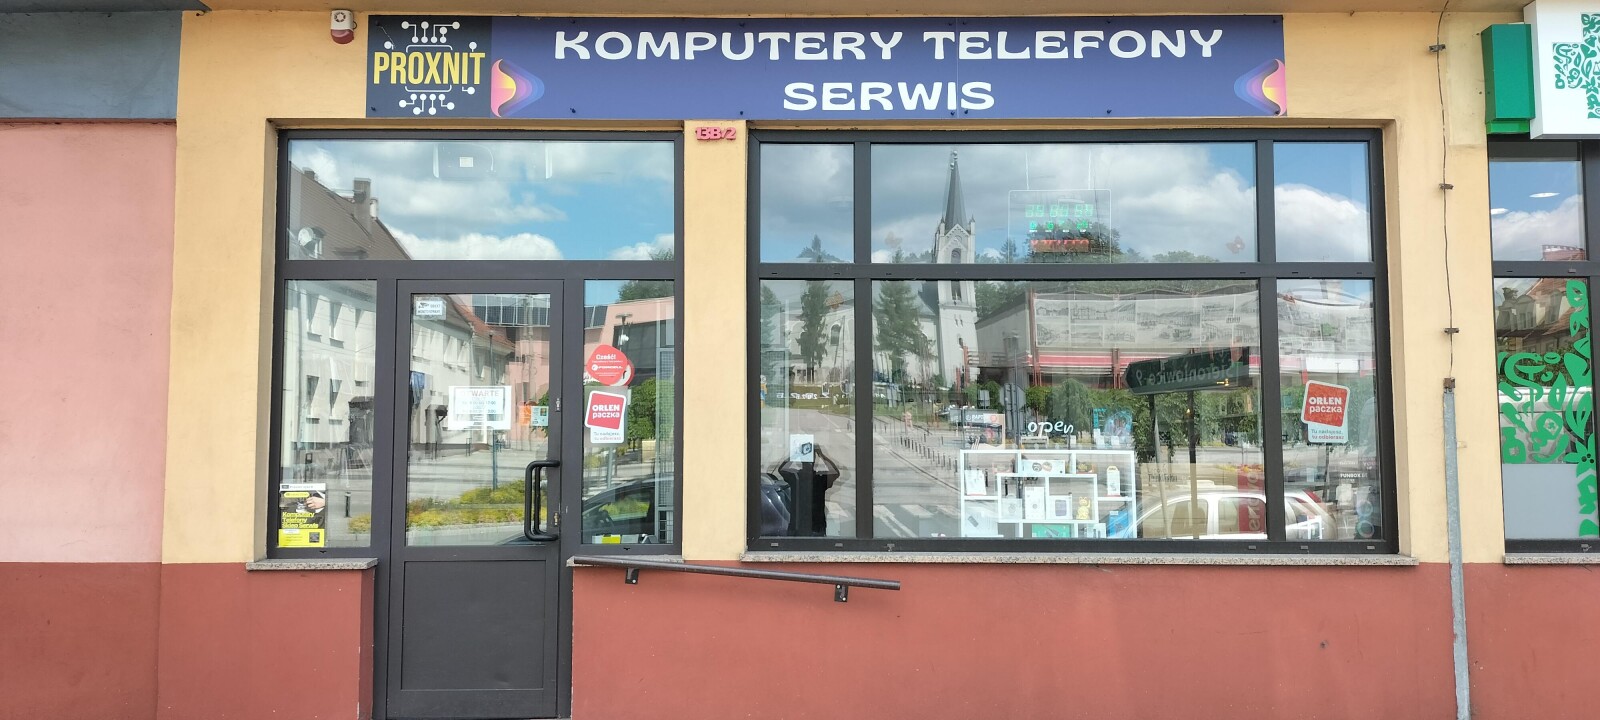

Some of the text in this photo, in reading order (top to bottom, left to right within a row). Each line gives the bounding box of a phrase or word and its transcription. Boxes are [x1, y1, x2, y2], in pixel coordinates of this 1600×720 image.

[554, 28, 1224, 61] KOMPUTERY TELEFONY
[373, 51, 485, 85] PROXNIT
[783, 81, 995, 111] SERWIS
[695, 127, 737, 140] 13B/2
[1308, 396, 1342, 405] ORLEN
[592, 403, 620, 412] ORLEN
[1309, 405, 1343, 416] paczka
[592, 411, 621, 420] paczka
[1027, 420, 1074, 439] open
